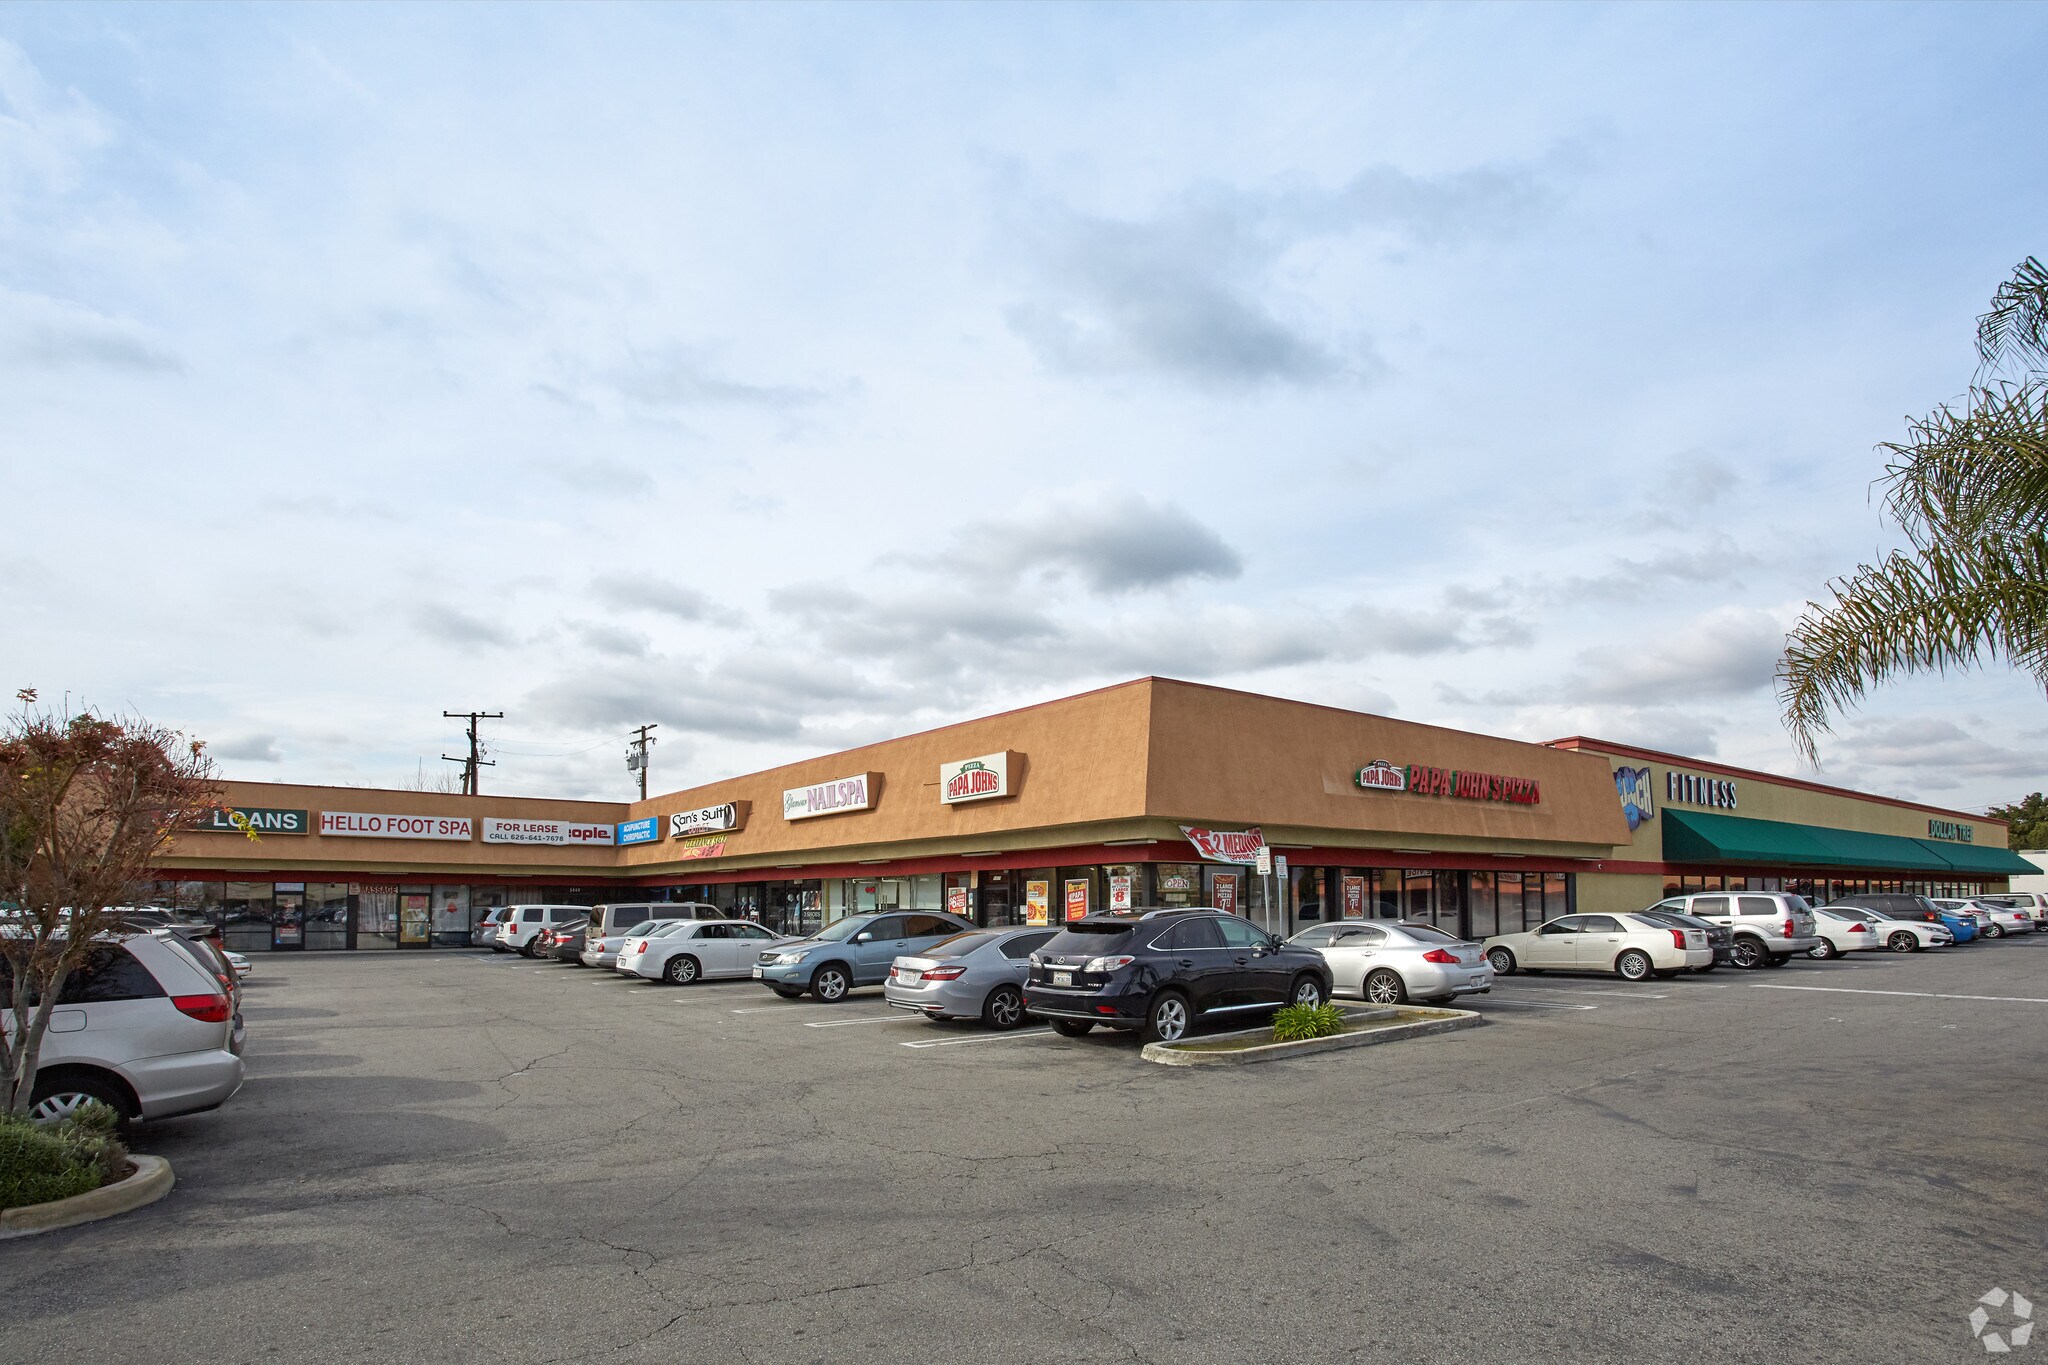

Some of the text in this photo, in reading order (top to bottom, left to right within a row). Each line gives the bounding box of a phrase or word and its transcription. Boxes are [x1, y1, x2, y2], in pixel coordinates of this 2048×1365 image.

[964, 762, 980, 770] PIZZA
[1362, 769, 1380, 785] PAPA
[1407, 764, 1540, 804] PAPA JOHN'S PIZZA
[948, 773, 969, 797] PAPA
[1667, 771, 1737, 809] FITNESS
[213, 810, 298, 829] LOANS
[321, 814, 471, 836] HELLO FOOT SPA
[623, 820, 651, 833] ACUPUNCTURE
[672, 811, 698, 836] San's
[496, 822, 558, 833] FOR LEASE
[569, 827, 611, 841] ople
[687, 822, 710, 835] OUTLET
[1929, 819, 1974, 842] DOLLAR TREE
[489, 833, 564, 842] CALL 626-641-7678
[623, 830, 651, 842] CHIROPRACTIC
[1222, 833, 1264, 854] MEDIUM
[360, 885, 398, 894] MASSAGE
[1166, 878, 1189, 888] OPEN
